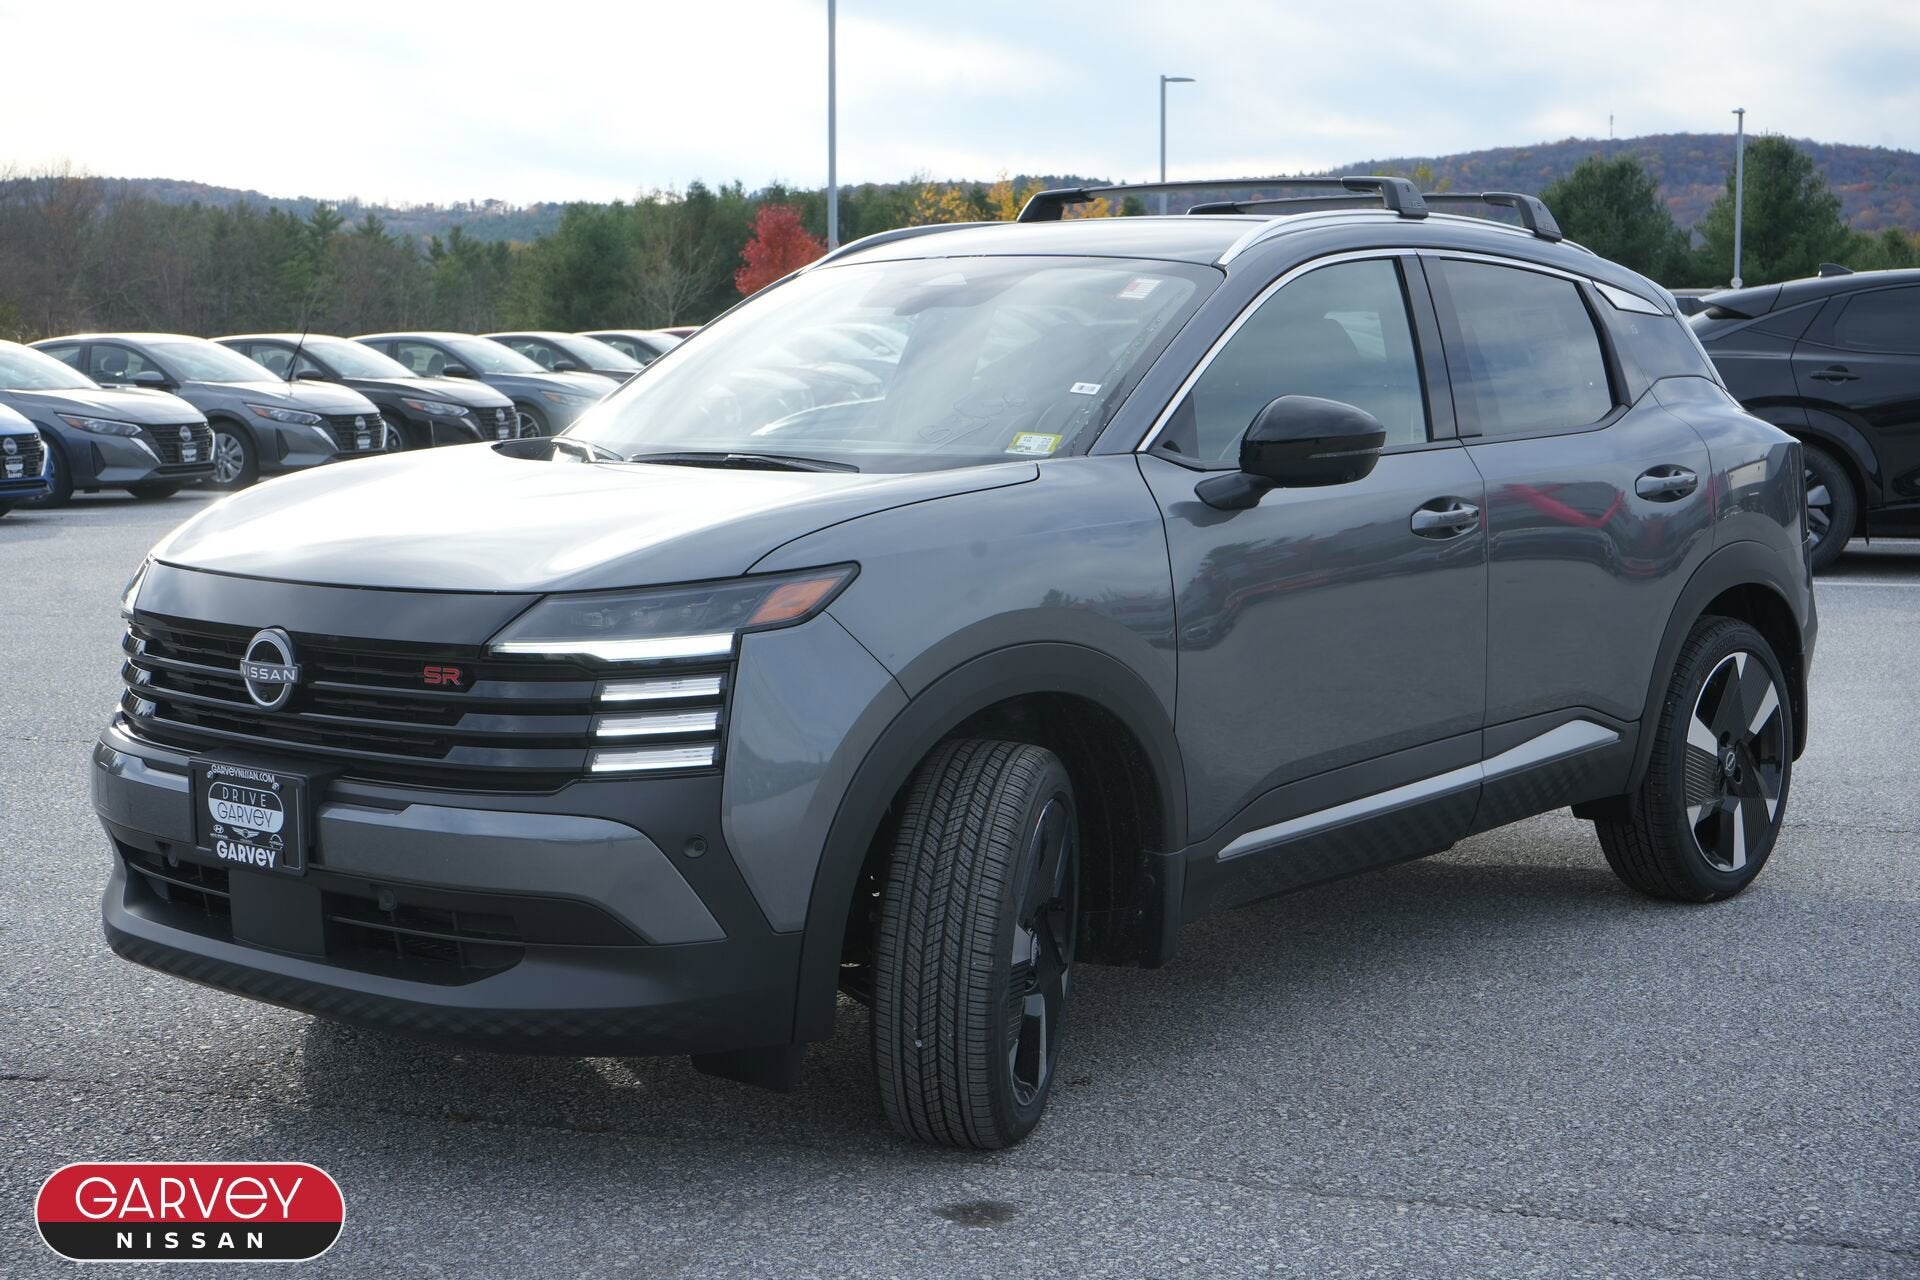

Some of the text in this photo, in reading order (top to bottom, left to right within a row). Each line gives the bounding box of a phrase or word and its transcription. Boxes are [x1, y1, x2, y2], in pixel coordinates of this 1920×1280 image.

[240, 663, 295, 681] NISSAN
[423, 666, 463, 685] SR
[222, 786, 267, 807] DRIVE
